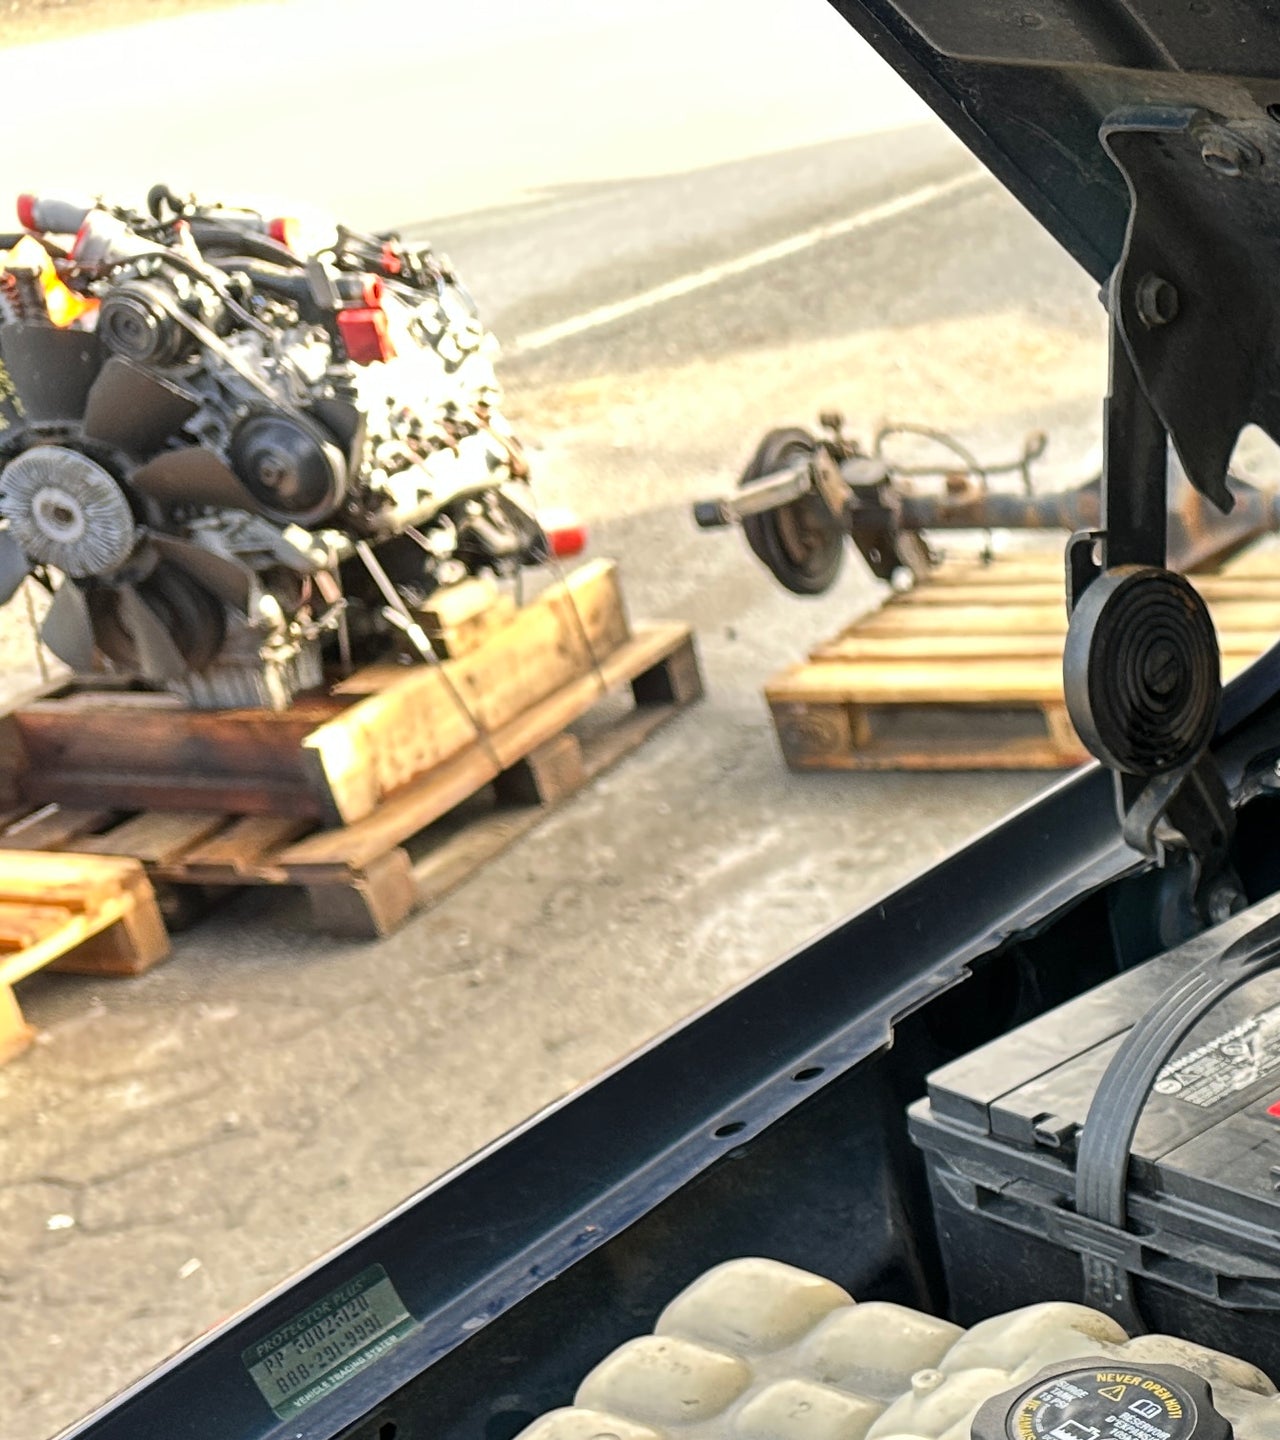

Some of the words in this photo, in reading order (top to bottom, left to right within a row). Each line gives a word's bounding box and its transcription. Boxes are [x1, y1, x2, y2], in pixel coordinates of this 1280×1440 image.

[256, 1302, 333, 1357] PROTECTOR
[332, 1279, 365, 1305] PLUS
[293, 1381, 330, 1408] VEHICLE
[1096, 1373, 1142, 1386] NEVER
[1143, 1380, 1172, 1402] OPEN
[1164, 1396, 1183, 1420] HOT!
